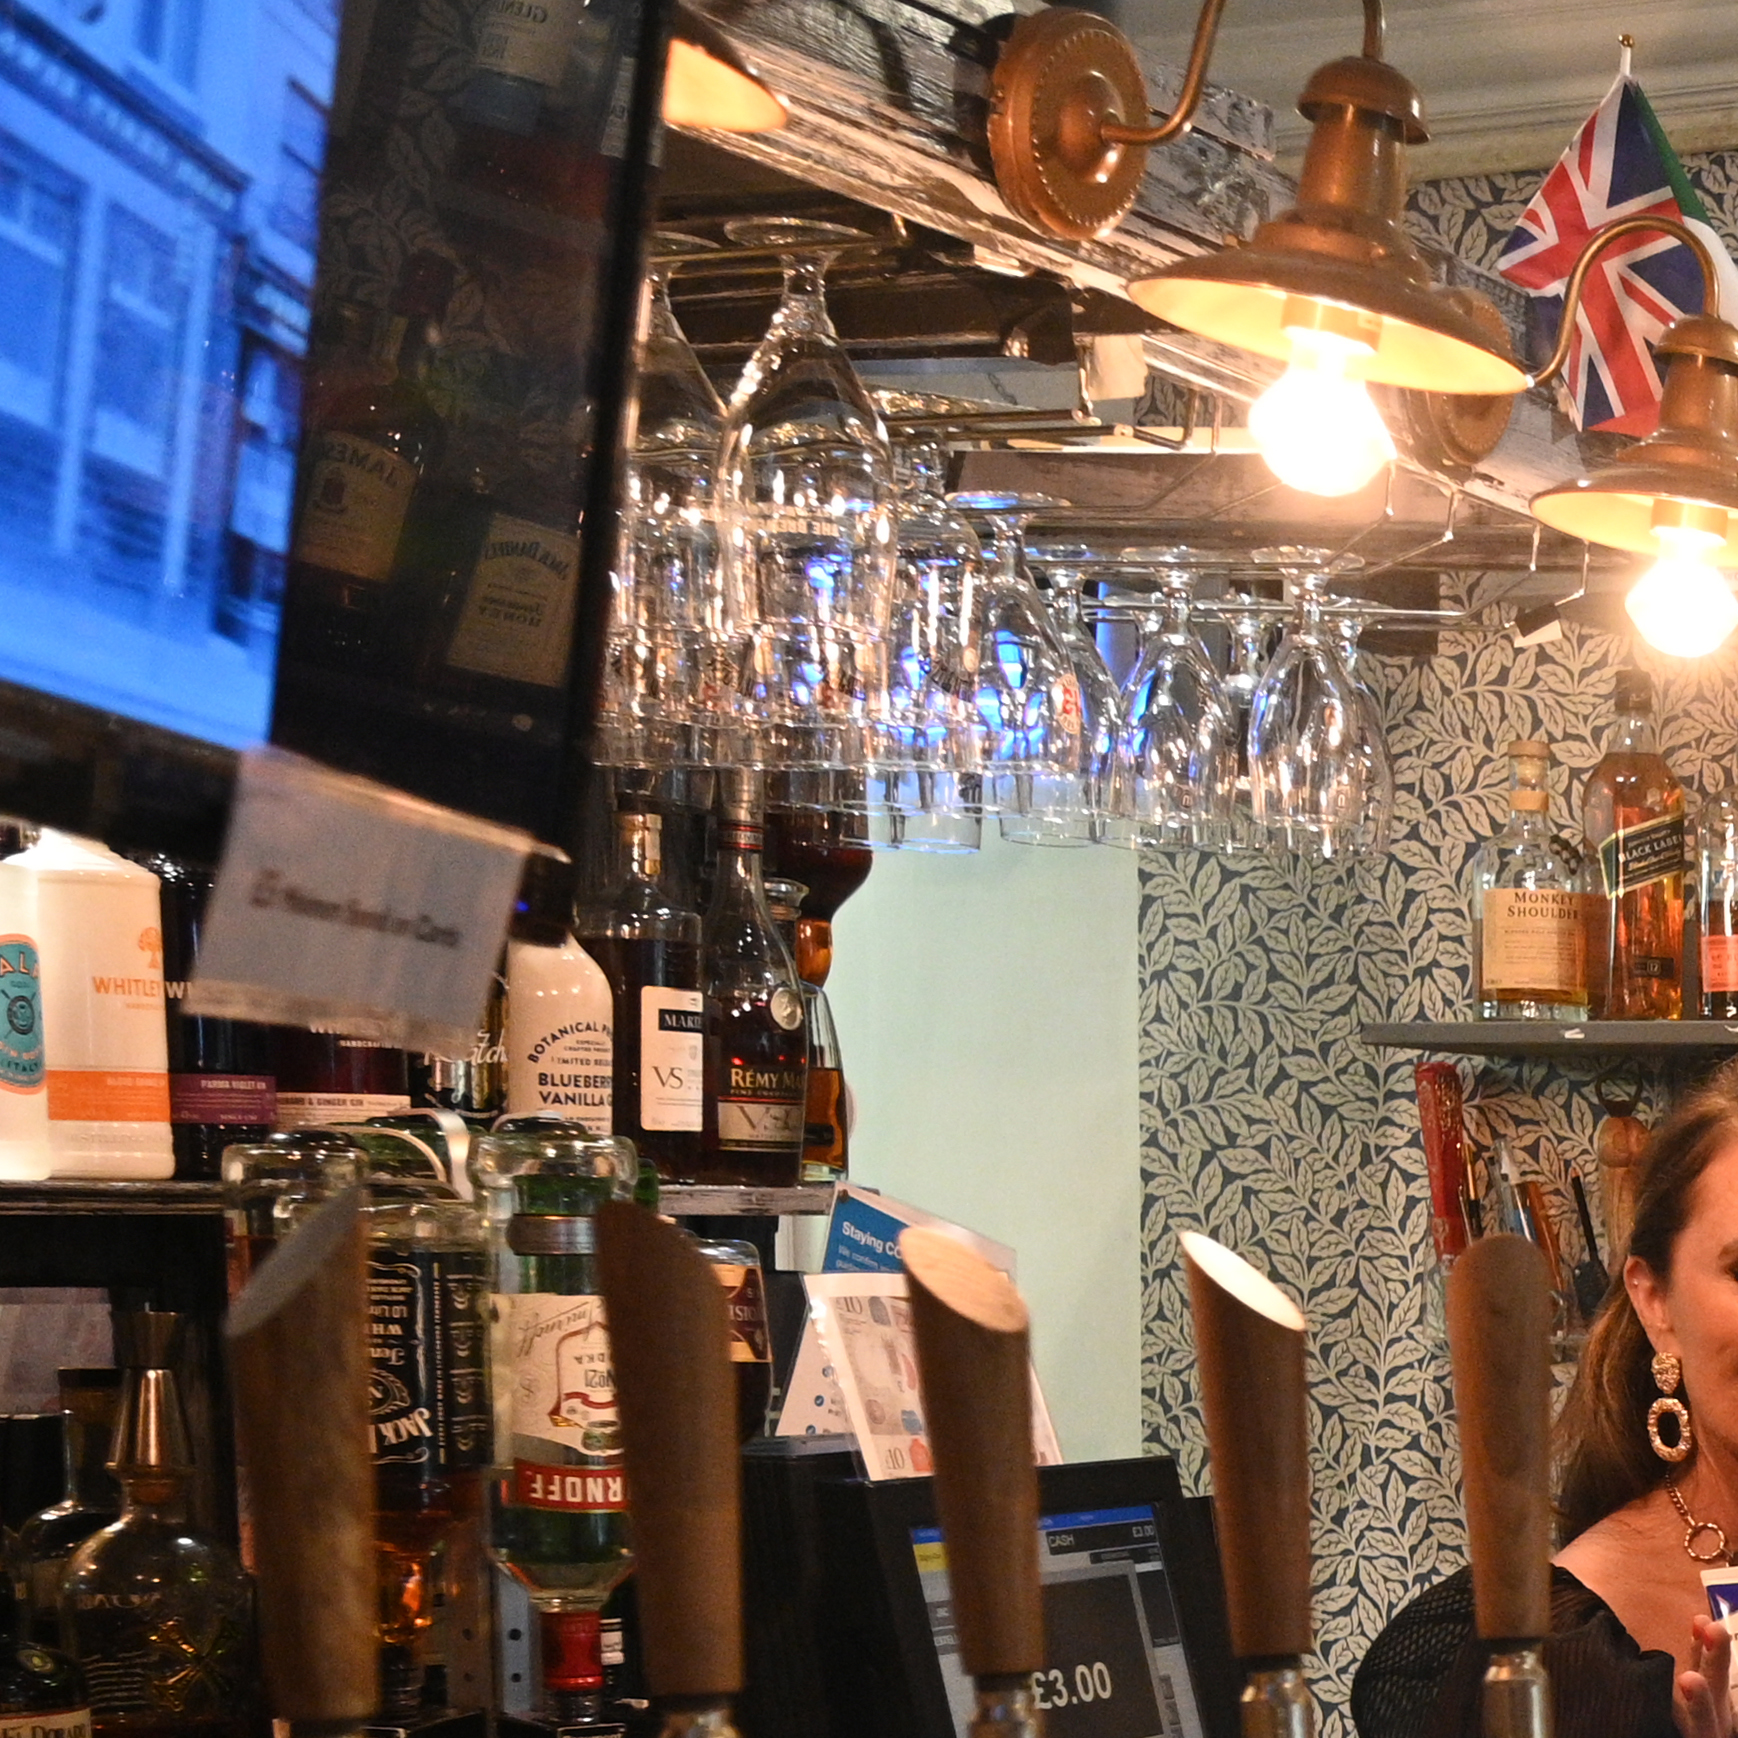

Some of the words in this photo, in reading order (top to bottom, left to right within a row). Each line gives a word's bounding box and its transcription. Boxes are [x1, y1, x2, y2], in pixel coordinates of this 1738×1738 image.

[1514, 891, 1574, 907] MONKEY
[1507, 906, 1580, 920] SHOULDER
[527, 1021, 600, 1064] BOTANICAL
[652, 1065, 684, 1090] VS
[731, 1067, 778, 1089] RÉMY
[539, 1091, 605, 1106] VANILLA
[842, 1221, 884, 1253] Staying
[574, 1355, 605, 1364] DKA
[380, 1407, 434, 1447] JACK
[529, 1474, 624, 1505] RNOFF
[1049, 1534, 1075, 1547] CASH
[1030, 1661, 1113, 1710] £3.00
